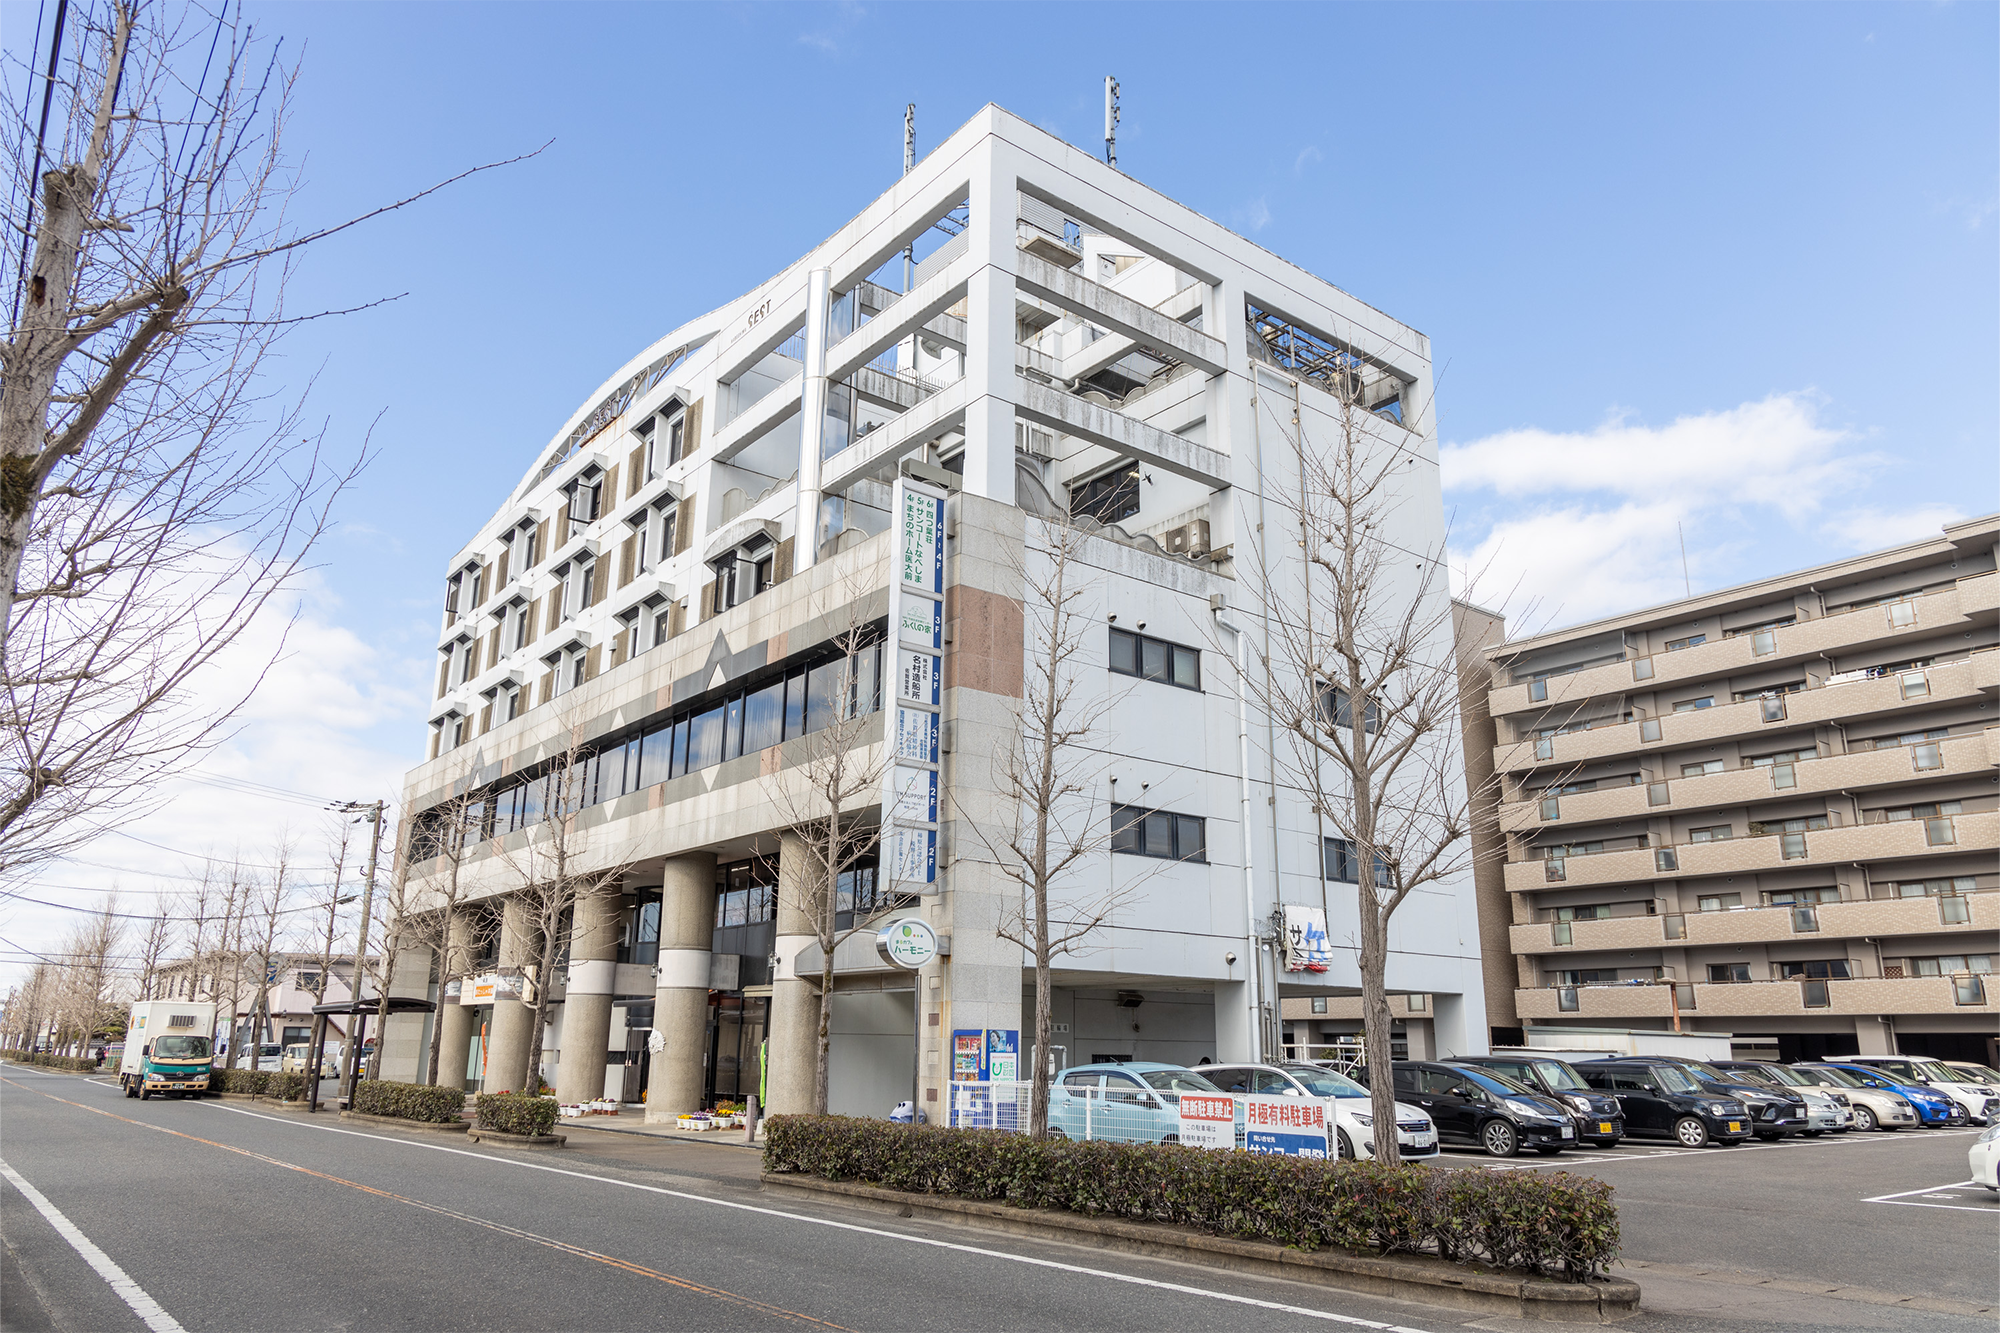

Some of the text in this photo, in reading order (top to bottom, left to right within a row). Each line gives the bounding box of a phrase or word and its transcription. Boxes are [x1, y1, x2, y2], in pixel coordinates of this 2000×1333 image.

[748, 299, 771, 328] SEST
[904, 504, 915, 581] まちのホーム医大前
[901, 619, 932, 635] ふくしの家
[911, 654, 921, 700] 名村造船所
[894, 945, 932, 955] ハーモニー
[1181, 1099, 1232, 1119] 無断駐車禁止
[1248, 1102, 1324, 1130] 月極有料駐車場
[1185, 1123, 1217, 1133] この駐車場は
[1181, 1133, 1217, 1144] 月極駐車場です
[1253, 1134, 1276, 1144] 問い合せ先
